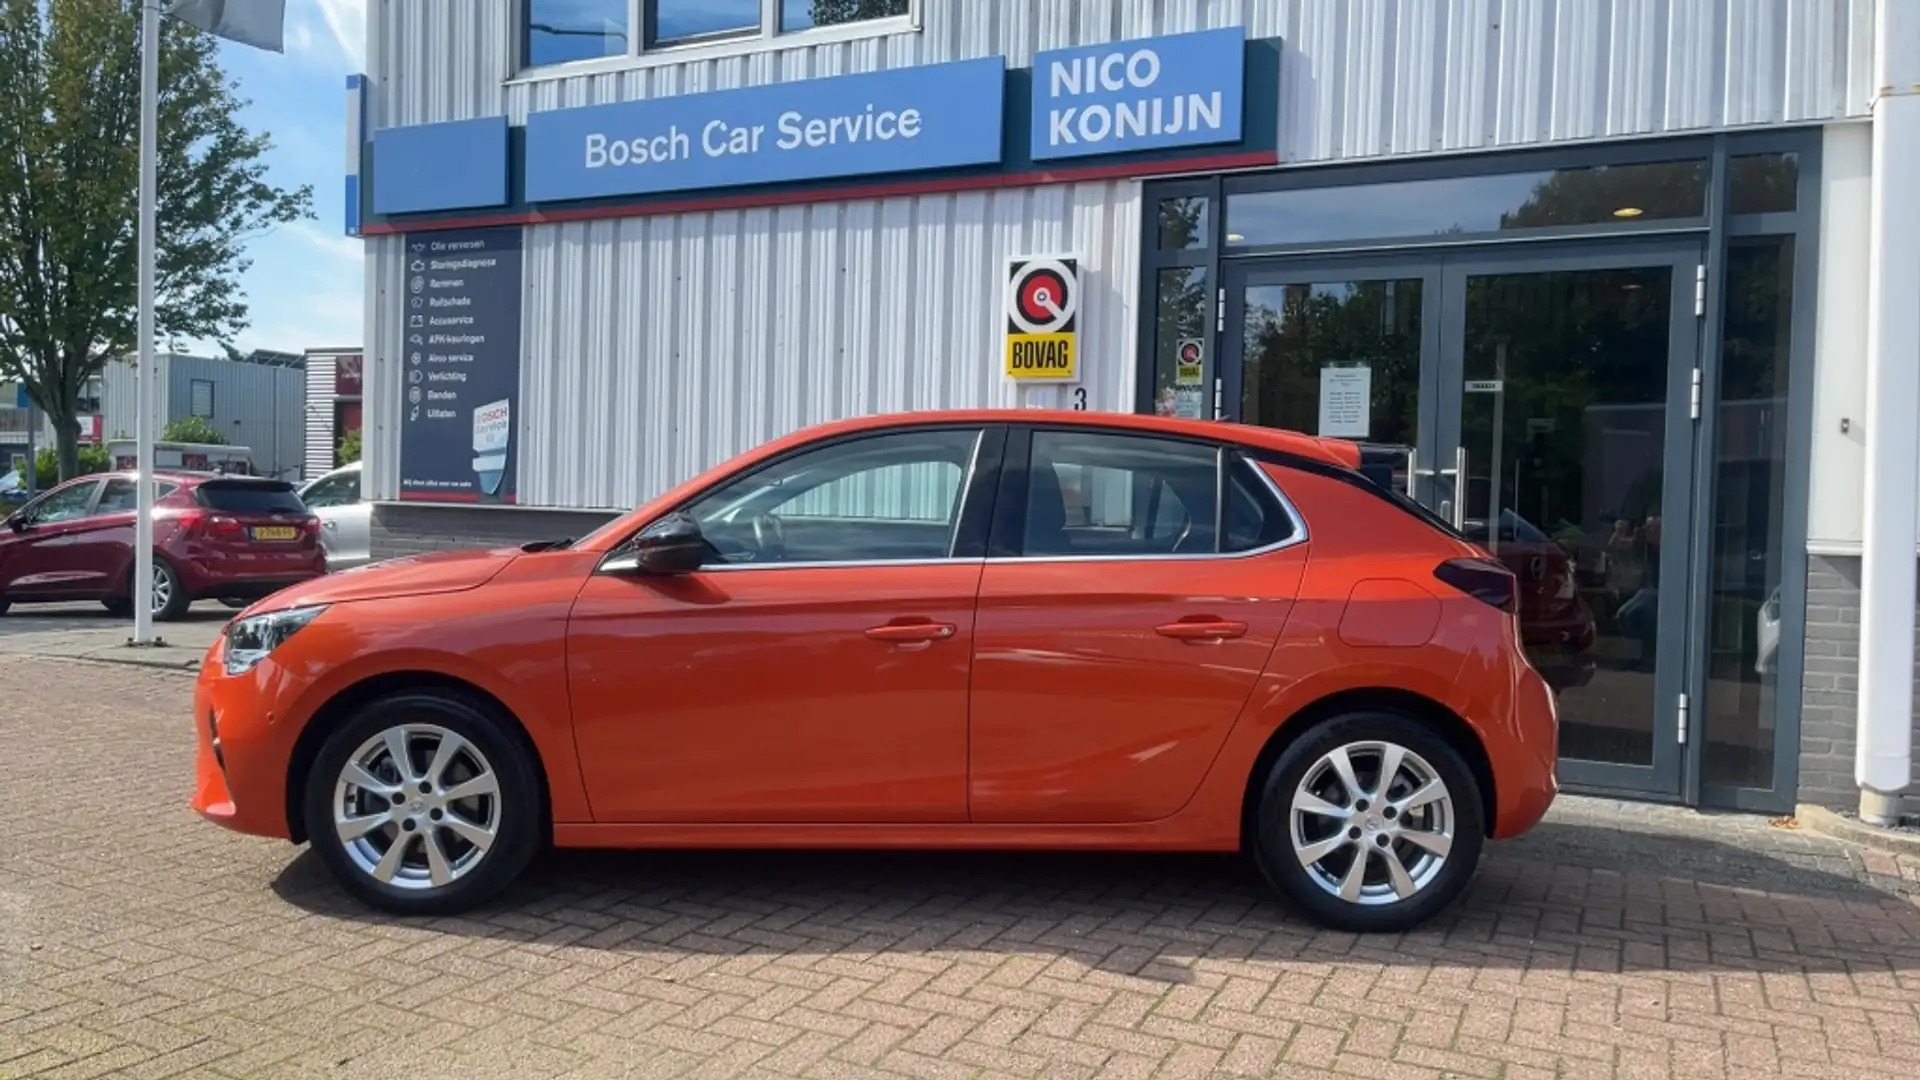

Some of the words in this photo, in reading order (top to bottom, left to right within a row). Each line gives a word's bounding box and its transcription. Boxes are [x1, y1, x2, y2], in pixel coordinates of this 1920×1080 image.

[1051, 49, 1161, 98] NICO
[585, 125, 690, 168] Bosch
[701, 119, 765, 157] Car
[776, 103, 922, 150] Service
[1050, 91, 1222, 146] KONIJN
[1012, 340, 1069, 369] BOVAG
[1074, 386, 1088, 411] 3
